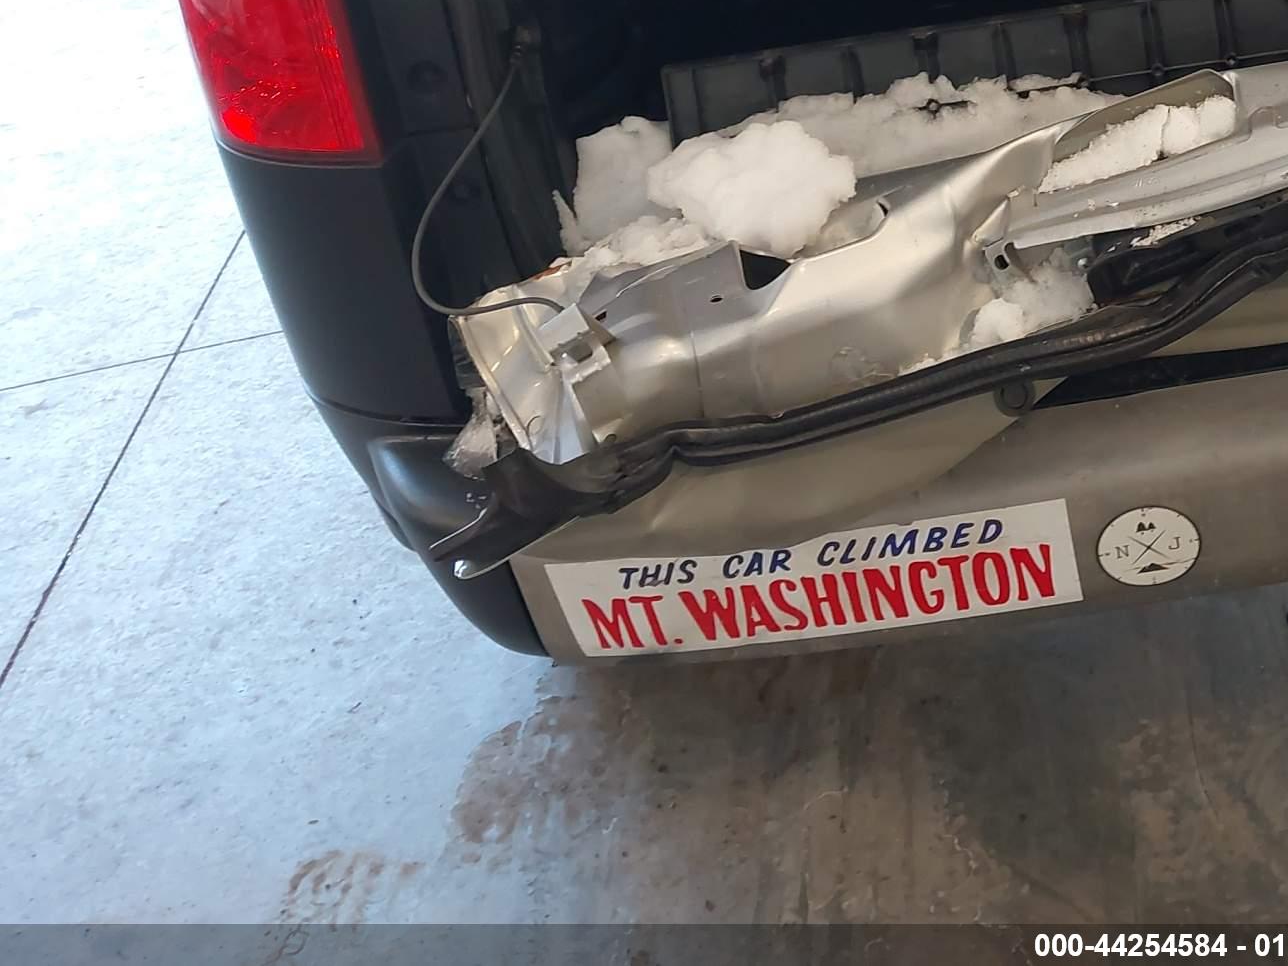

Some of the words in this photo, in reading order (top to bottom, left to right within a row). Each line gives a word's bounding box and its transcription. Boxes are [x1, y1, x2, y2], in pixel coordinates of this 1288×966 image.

[618, 559, 698, 590] THIS
[722, 548, 792, 579] CAR
[816, 518, 1004, 567] CLIMBED
[1114, 544, 1130, 560] N
[1167, 536, 1181, 551] J
[581, 594, 684, 650] MT.
[677, 543, 1056, 642] WASHINGTON
